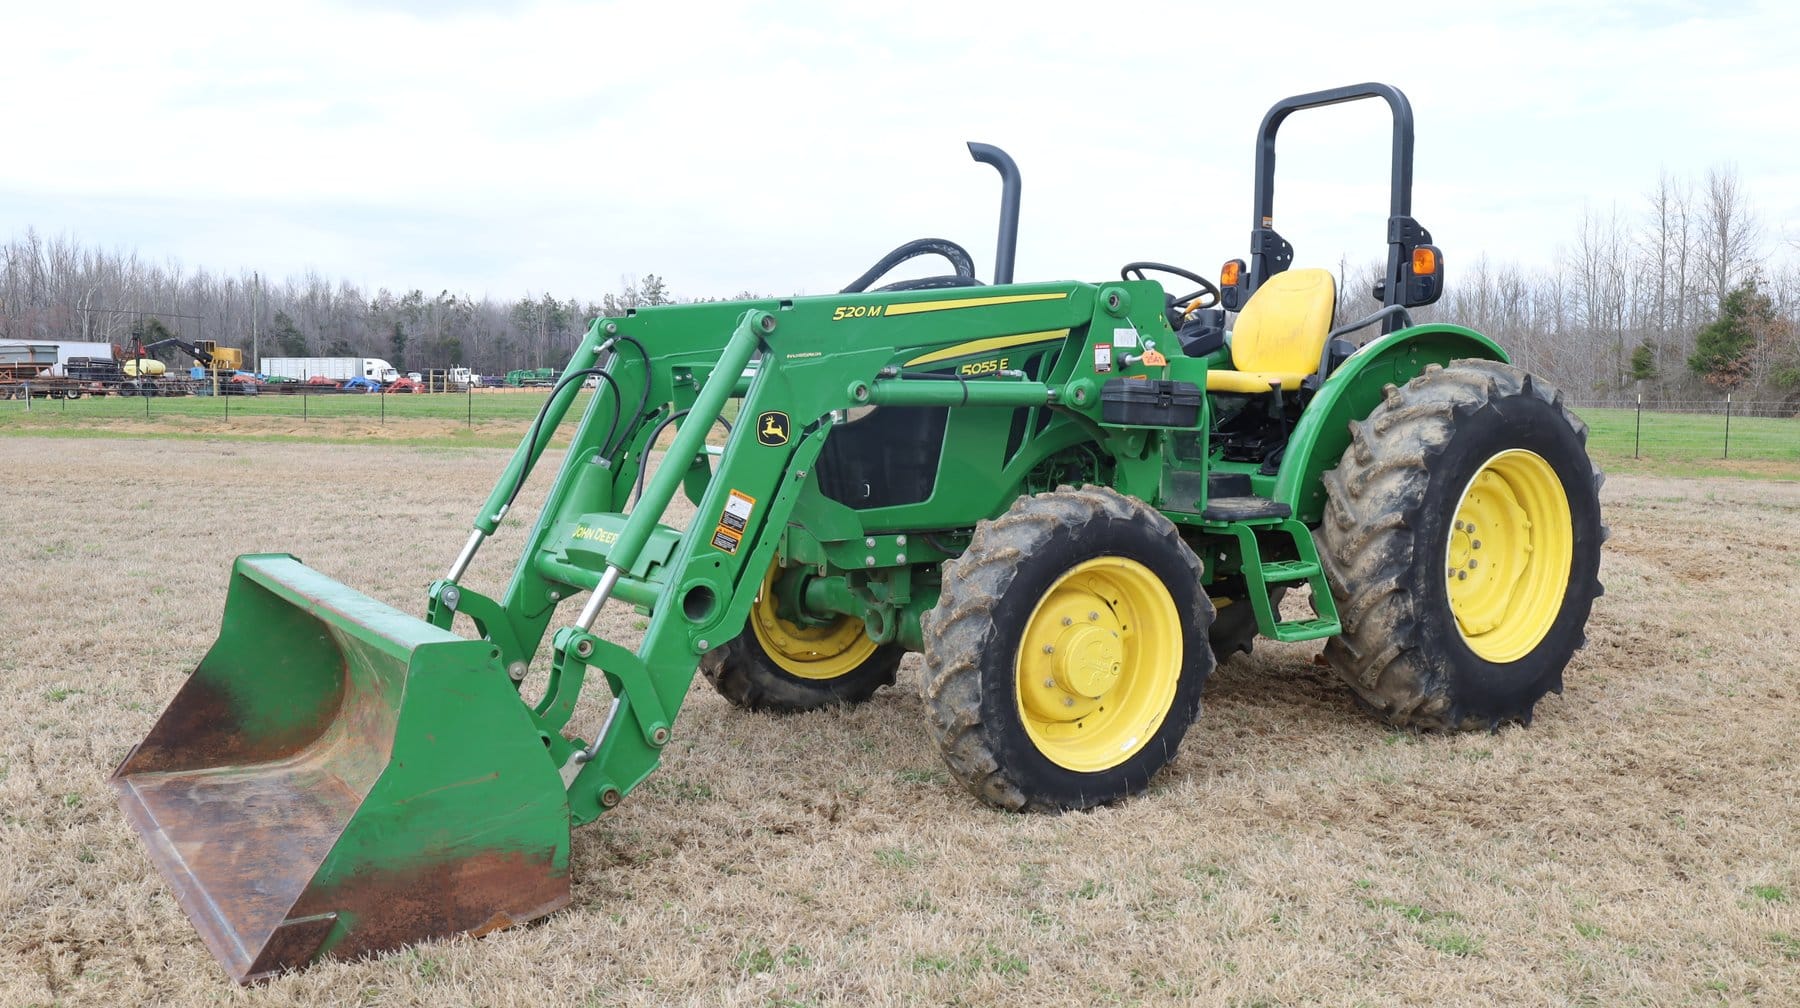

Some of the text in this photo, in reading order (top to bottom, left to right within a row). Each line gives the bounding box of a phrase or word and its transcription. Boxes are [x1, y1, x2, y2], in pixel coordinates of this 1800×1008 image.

[832, 305, 883, 321] 520 M
[961, 357, 1009, 376] 5055 E
[572, 525, 595, 539] JOHN
